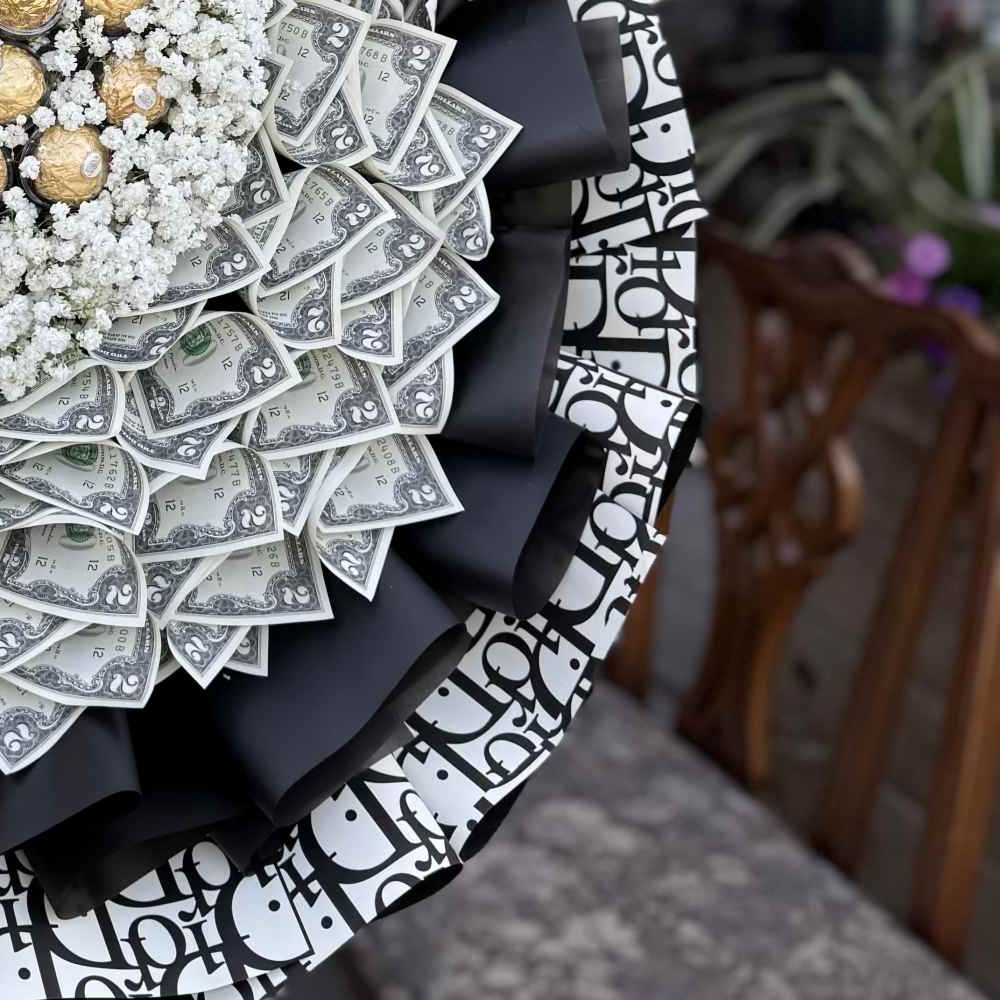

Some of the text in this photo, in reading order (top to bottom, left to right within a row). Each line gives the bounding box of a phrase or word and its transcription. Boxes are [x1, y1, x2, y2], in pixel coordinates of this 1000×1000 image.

[328, 22, 350, 48] 2
[408, 45, 431, 70] 2
[332, 127, 354, 149] 2
[474, 125, 496, 147] 2
[416, 154, 439, 177] 2
[251, 180, 270, 203] 2
[345, 204, 369, 225] 2
[401, 234, 425, 257] 2
[223, 253, 247, 276] 2
[451, 286, 476, 311] 2
[307, 307, 325, 332] 2
[251, 359, 276, 383] 2
[352, 402, 377, 422] 2
[416, 392, 433, 418] 2
[410, 485, 436, 504] 2
[100, 502, 127, 519] 2
[242, 505, 266, 527] 2
[106, 583, 132, 605] 2
[283, 586, 309, 603] 2
[186, 637, 208, 661] 2
[110, 673, 139, 693] 2
[4, 723, 32, 751] 2
